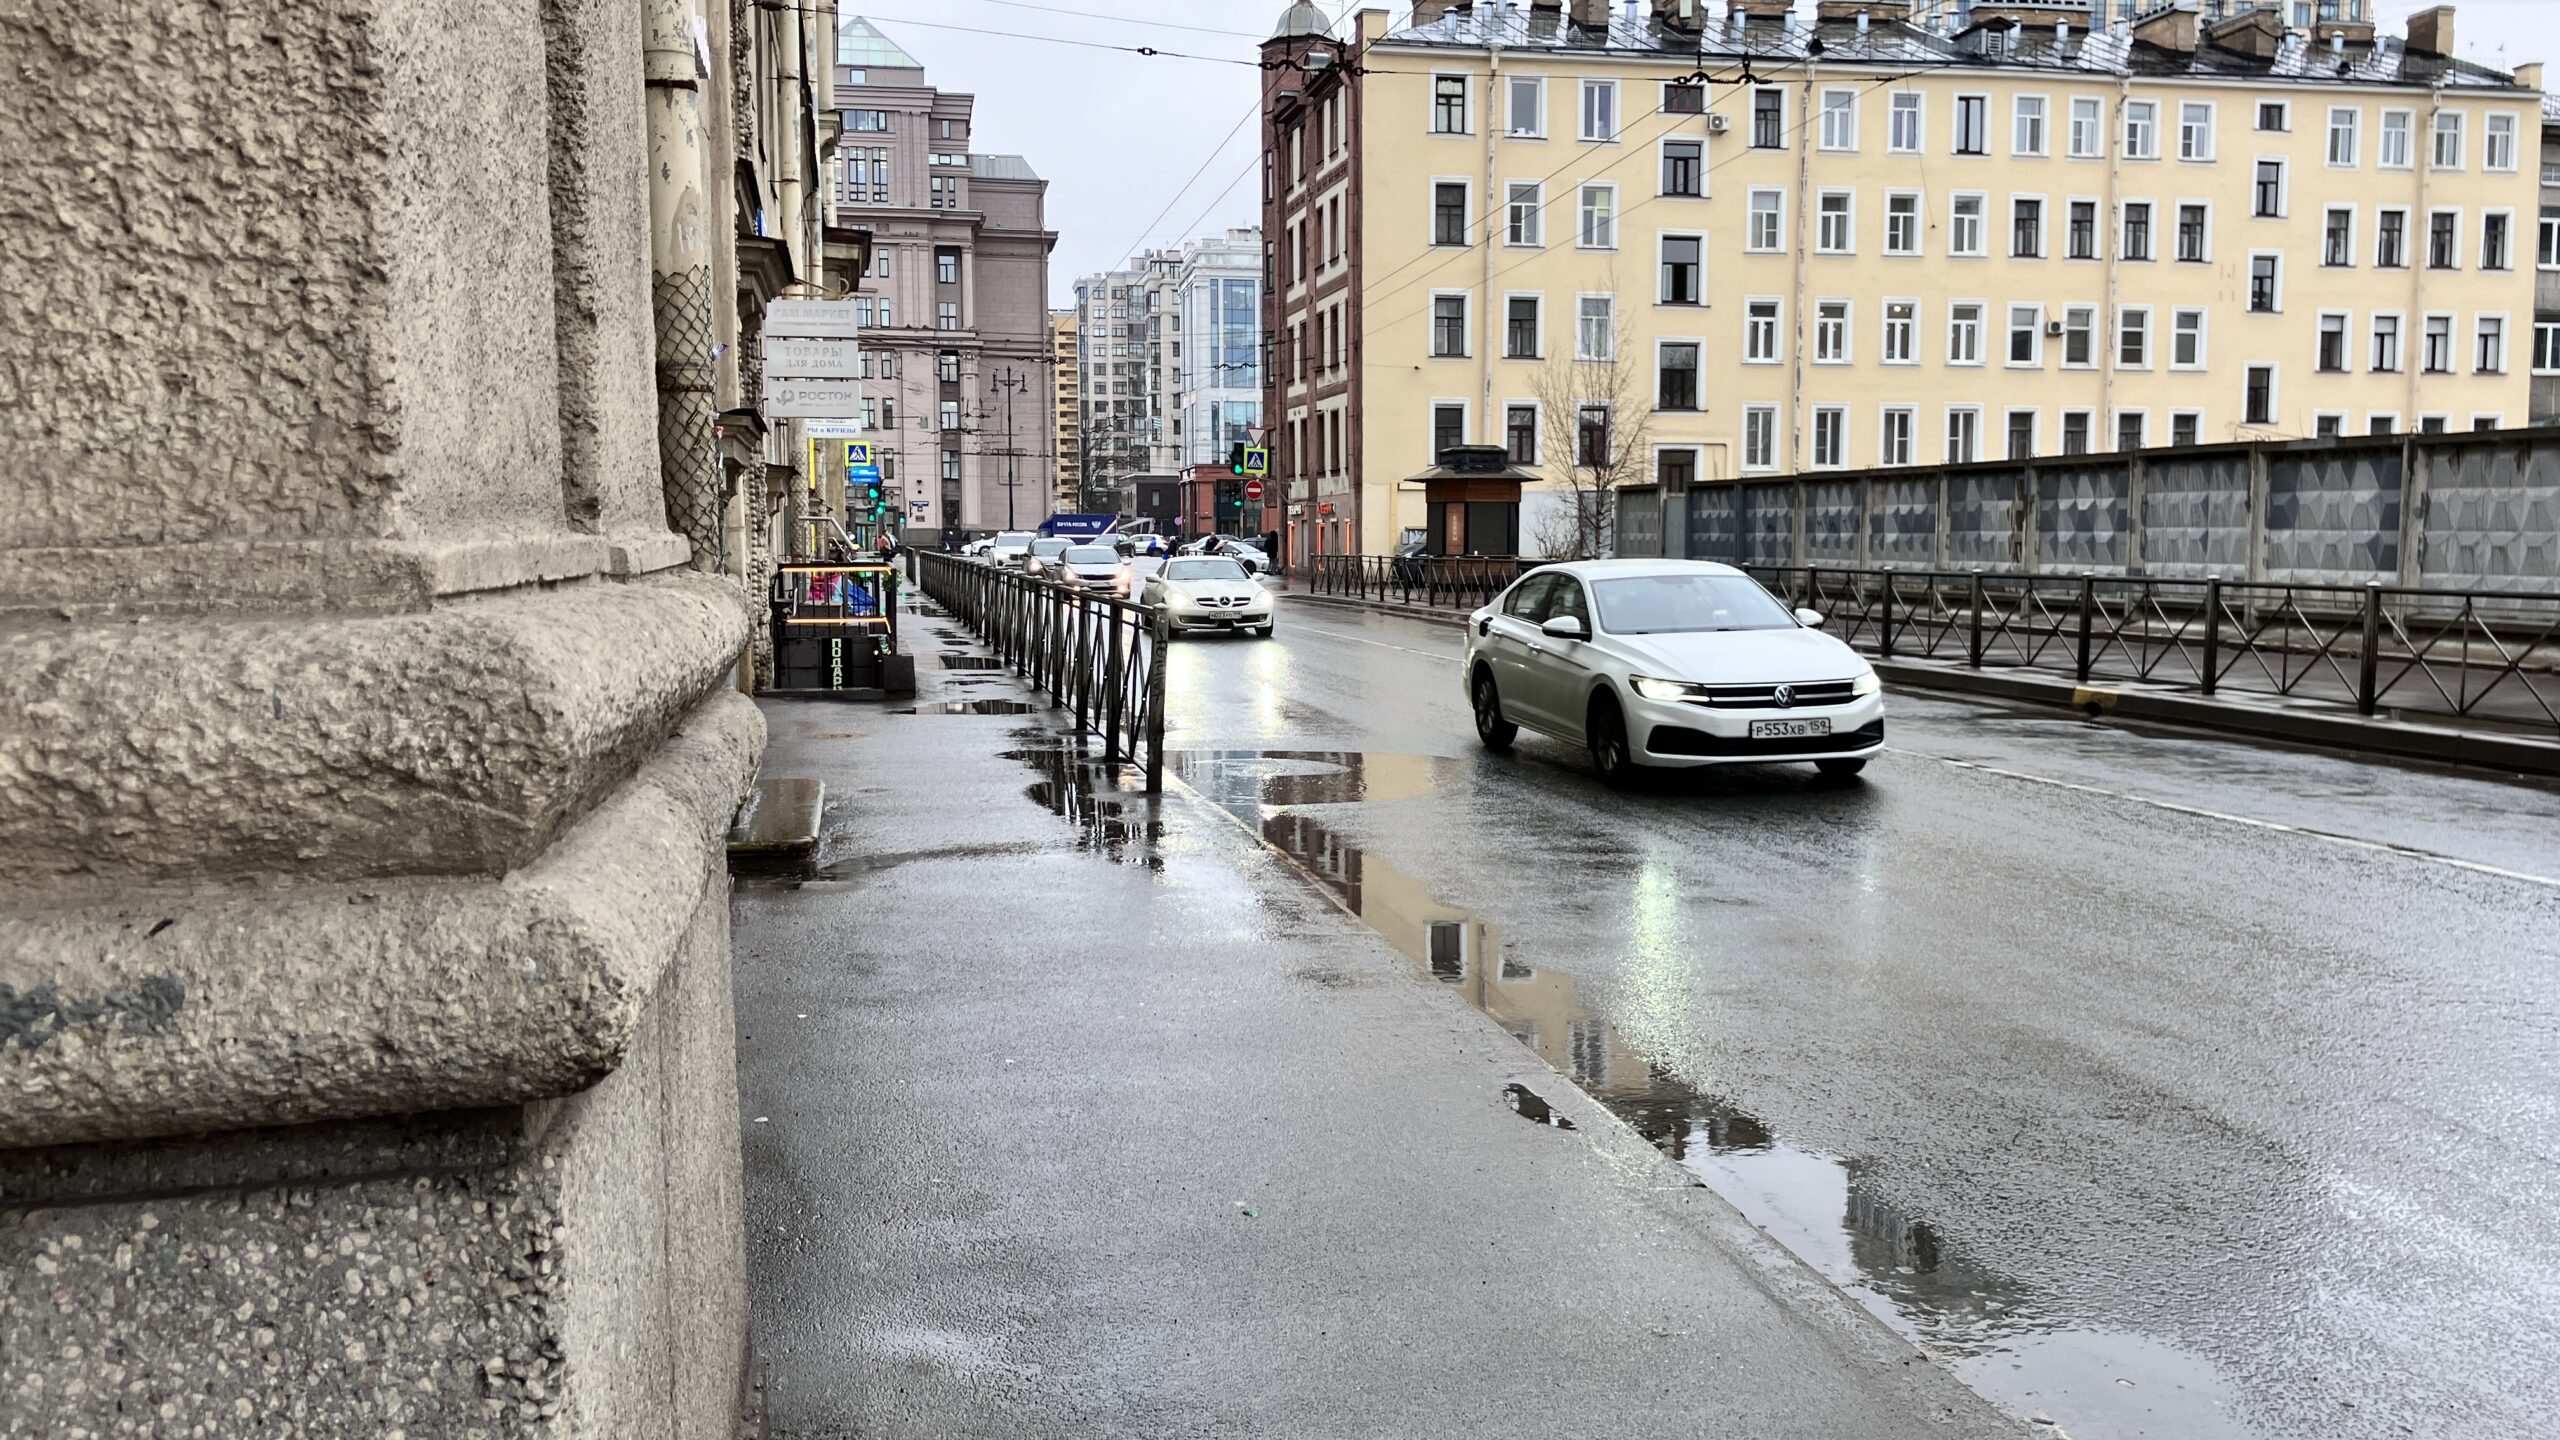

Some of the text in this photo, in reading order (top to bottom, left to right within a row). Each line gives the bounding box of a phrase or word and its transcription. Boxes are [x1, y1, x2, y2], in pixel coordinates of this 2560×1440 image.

[784, 346, 842, 357] ТОВАРЫ
[784, 359, 843, 368] ДЛЯ ДОМА
[798, 391, 853, 400] РОСТОК
